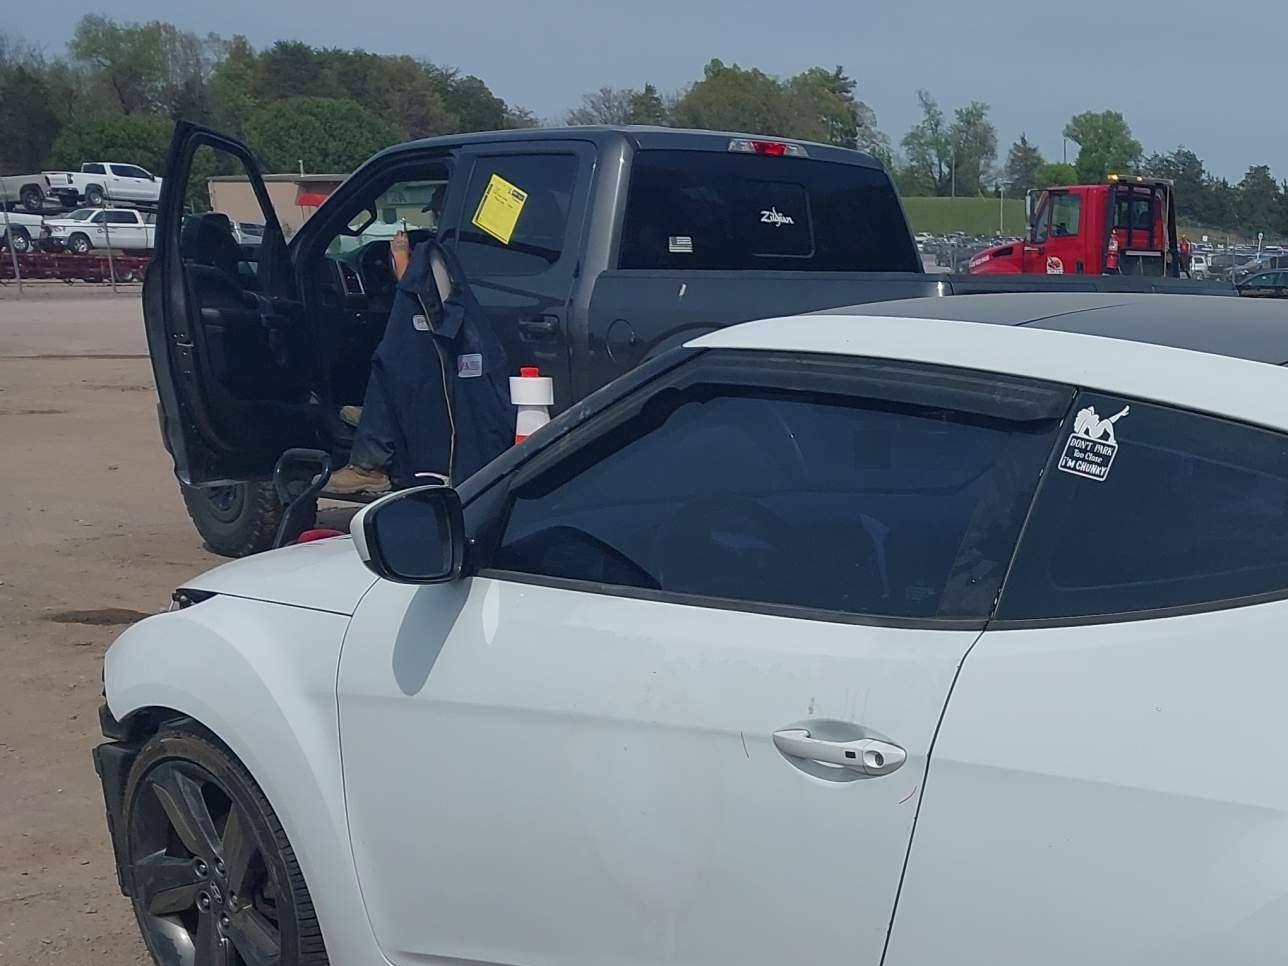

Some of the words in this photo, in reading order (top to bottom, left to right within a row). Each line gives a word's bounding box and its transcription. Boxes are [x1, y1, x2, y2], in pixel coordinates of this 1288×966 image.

[1073, 448, 1084, 458] Too
[1085, 452, 1103, 463] Close
[1094, 444, 1114, 456] PARK
[1076, 460, 1107, 476] CHUNKY
